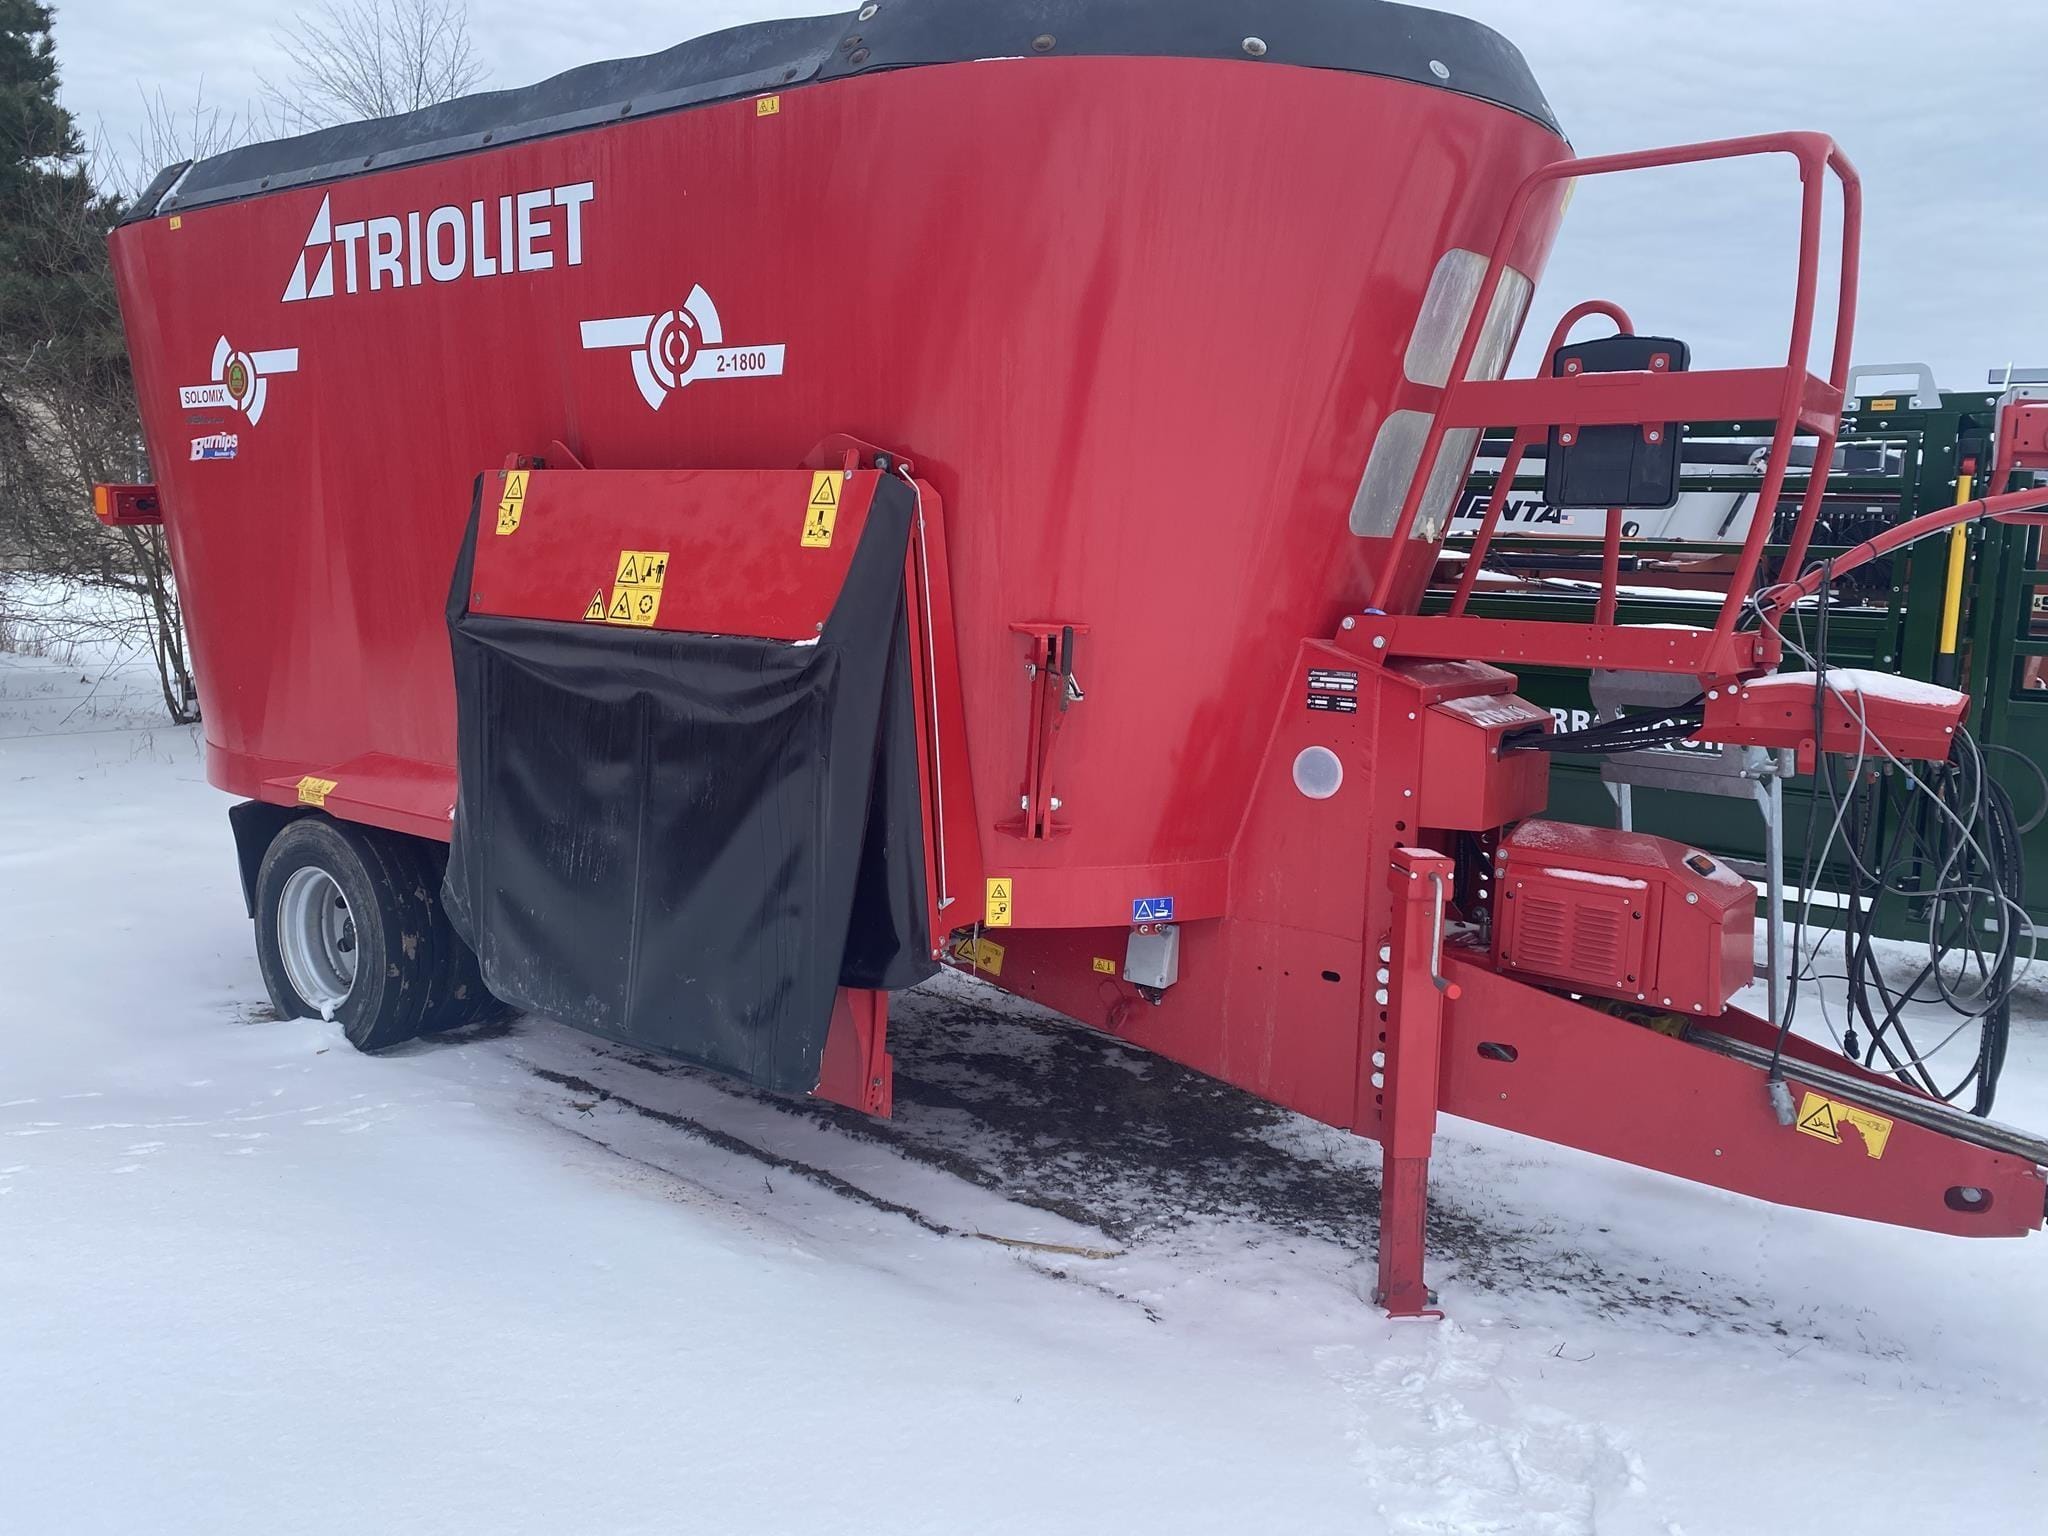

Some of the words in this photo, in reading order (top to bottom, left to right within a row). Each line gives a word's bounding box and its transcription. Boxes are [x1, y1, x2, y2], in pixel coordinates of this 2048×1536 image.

[334, 181, 594, 294] TRIOLIET
[717, 352, 766, 372] 2-1800
[184, 389, 225, 404] SOLOMIX
[190, 431, 238, 460] Burnips
